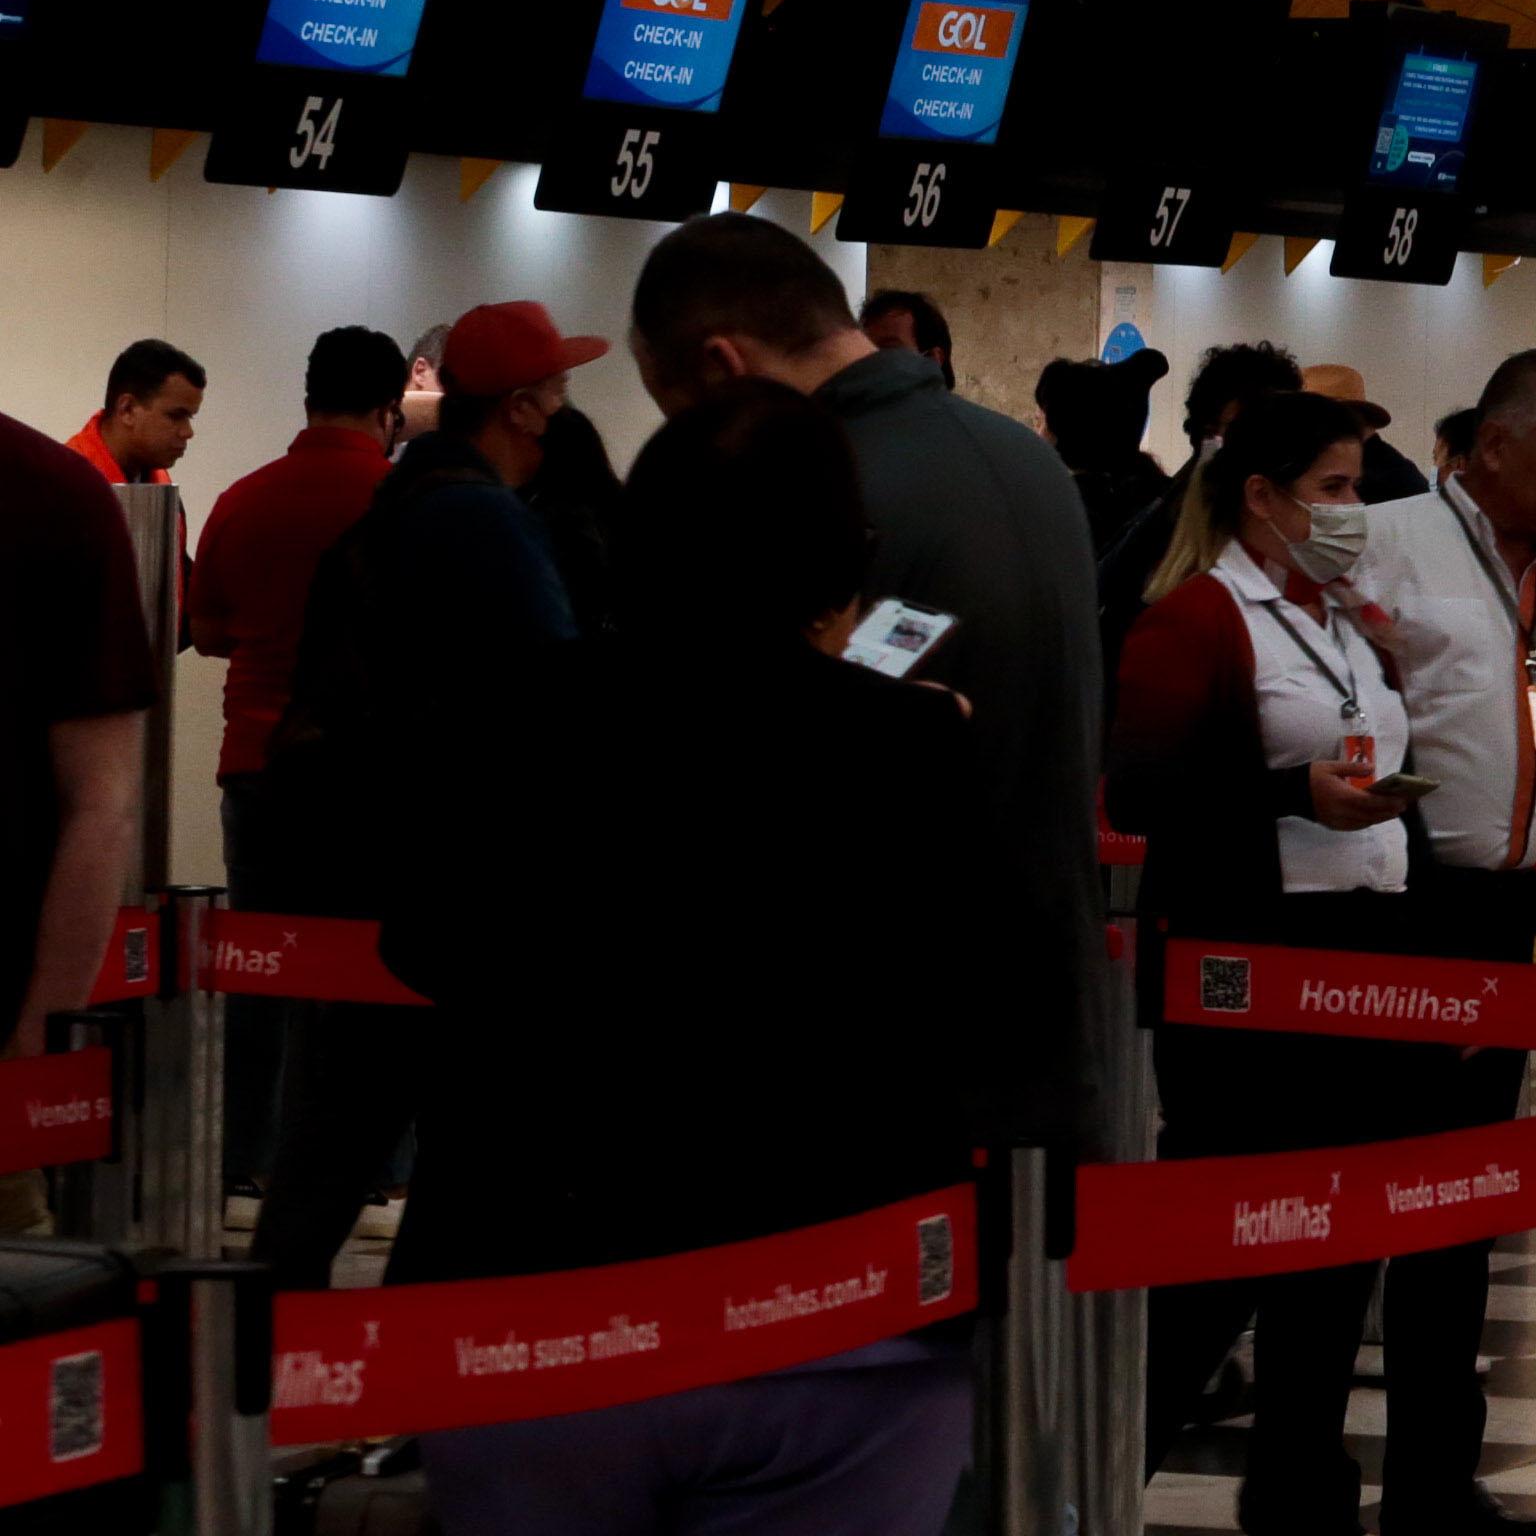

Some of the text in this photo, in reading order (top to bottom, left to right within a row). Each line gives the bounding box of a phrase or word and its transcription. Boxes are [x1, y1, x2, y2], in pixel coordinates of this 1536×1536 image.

[300, 20, 379, 48] CHECK-IN
[633, 23, 703, 50] CHECK-IN
[938, 10, 987, 51] GOL
[624, 60, 694, 86] CHECK-IN
[922, 64, 983, 86] CHECK-IN
[289, 95, 344, 171] 54
[913, 98, 974, 121] CHECK-IN
[610, 128, 661, 199] 55
[903, 162, 946, 228] 56
[1150, 186, 1192, 248] 57
[1383, 207, 1418, 266] 58
[1299, 979, 1481, 1025] HotMilhas
[1232, 1194, 1333, 1247] HotMilhas
[1386, 1176, 1434, 1214] Venda
[1437, 1176, 1471, 1204] suas
[1473, 1163, 1520, 1200] milhas
[455, 1264, 888, 1377] Venda suas milhas hotmilhas.com.br
